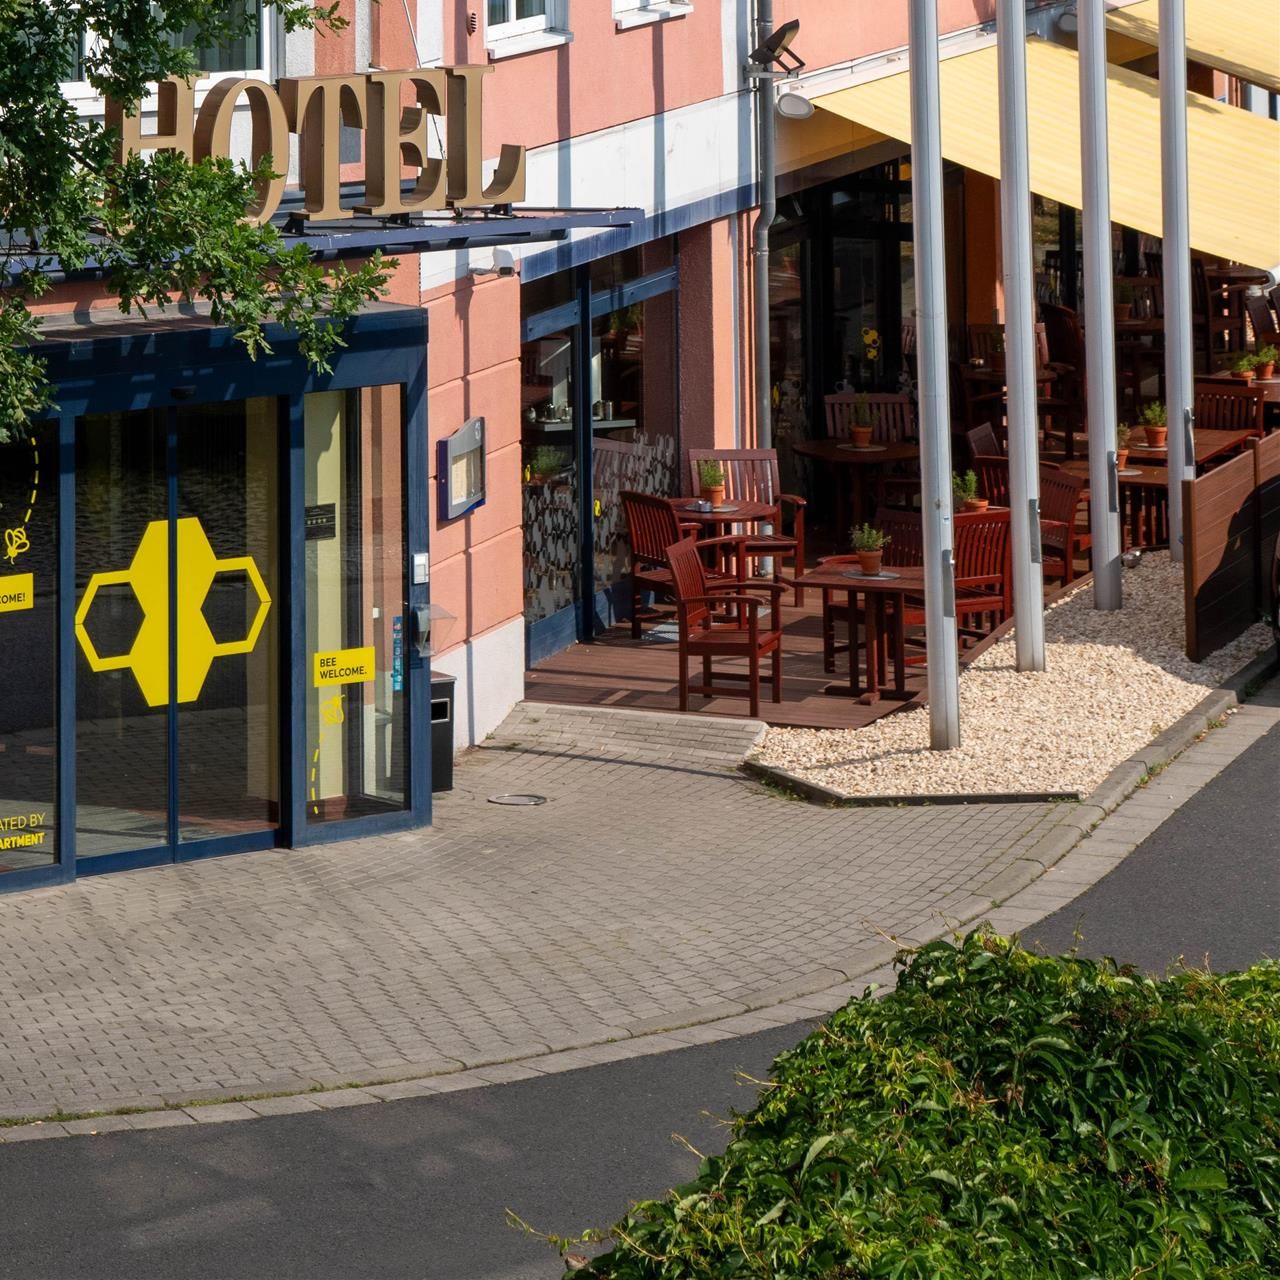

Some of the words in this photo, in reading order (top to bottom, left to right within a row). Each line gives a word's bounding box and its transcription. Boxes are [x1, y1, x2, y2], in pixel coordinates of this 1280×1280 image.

[105, 64, 527, 226] HOTEL
[320, 657, 337, 667] BEE
[320, 666, 367, 679] WELCOME.
[29, 811, 46, 827] BY
